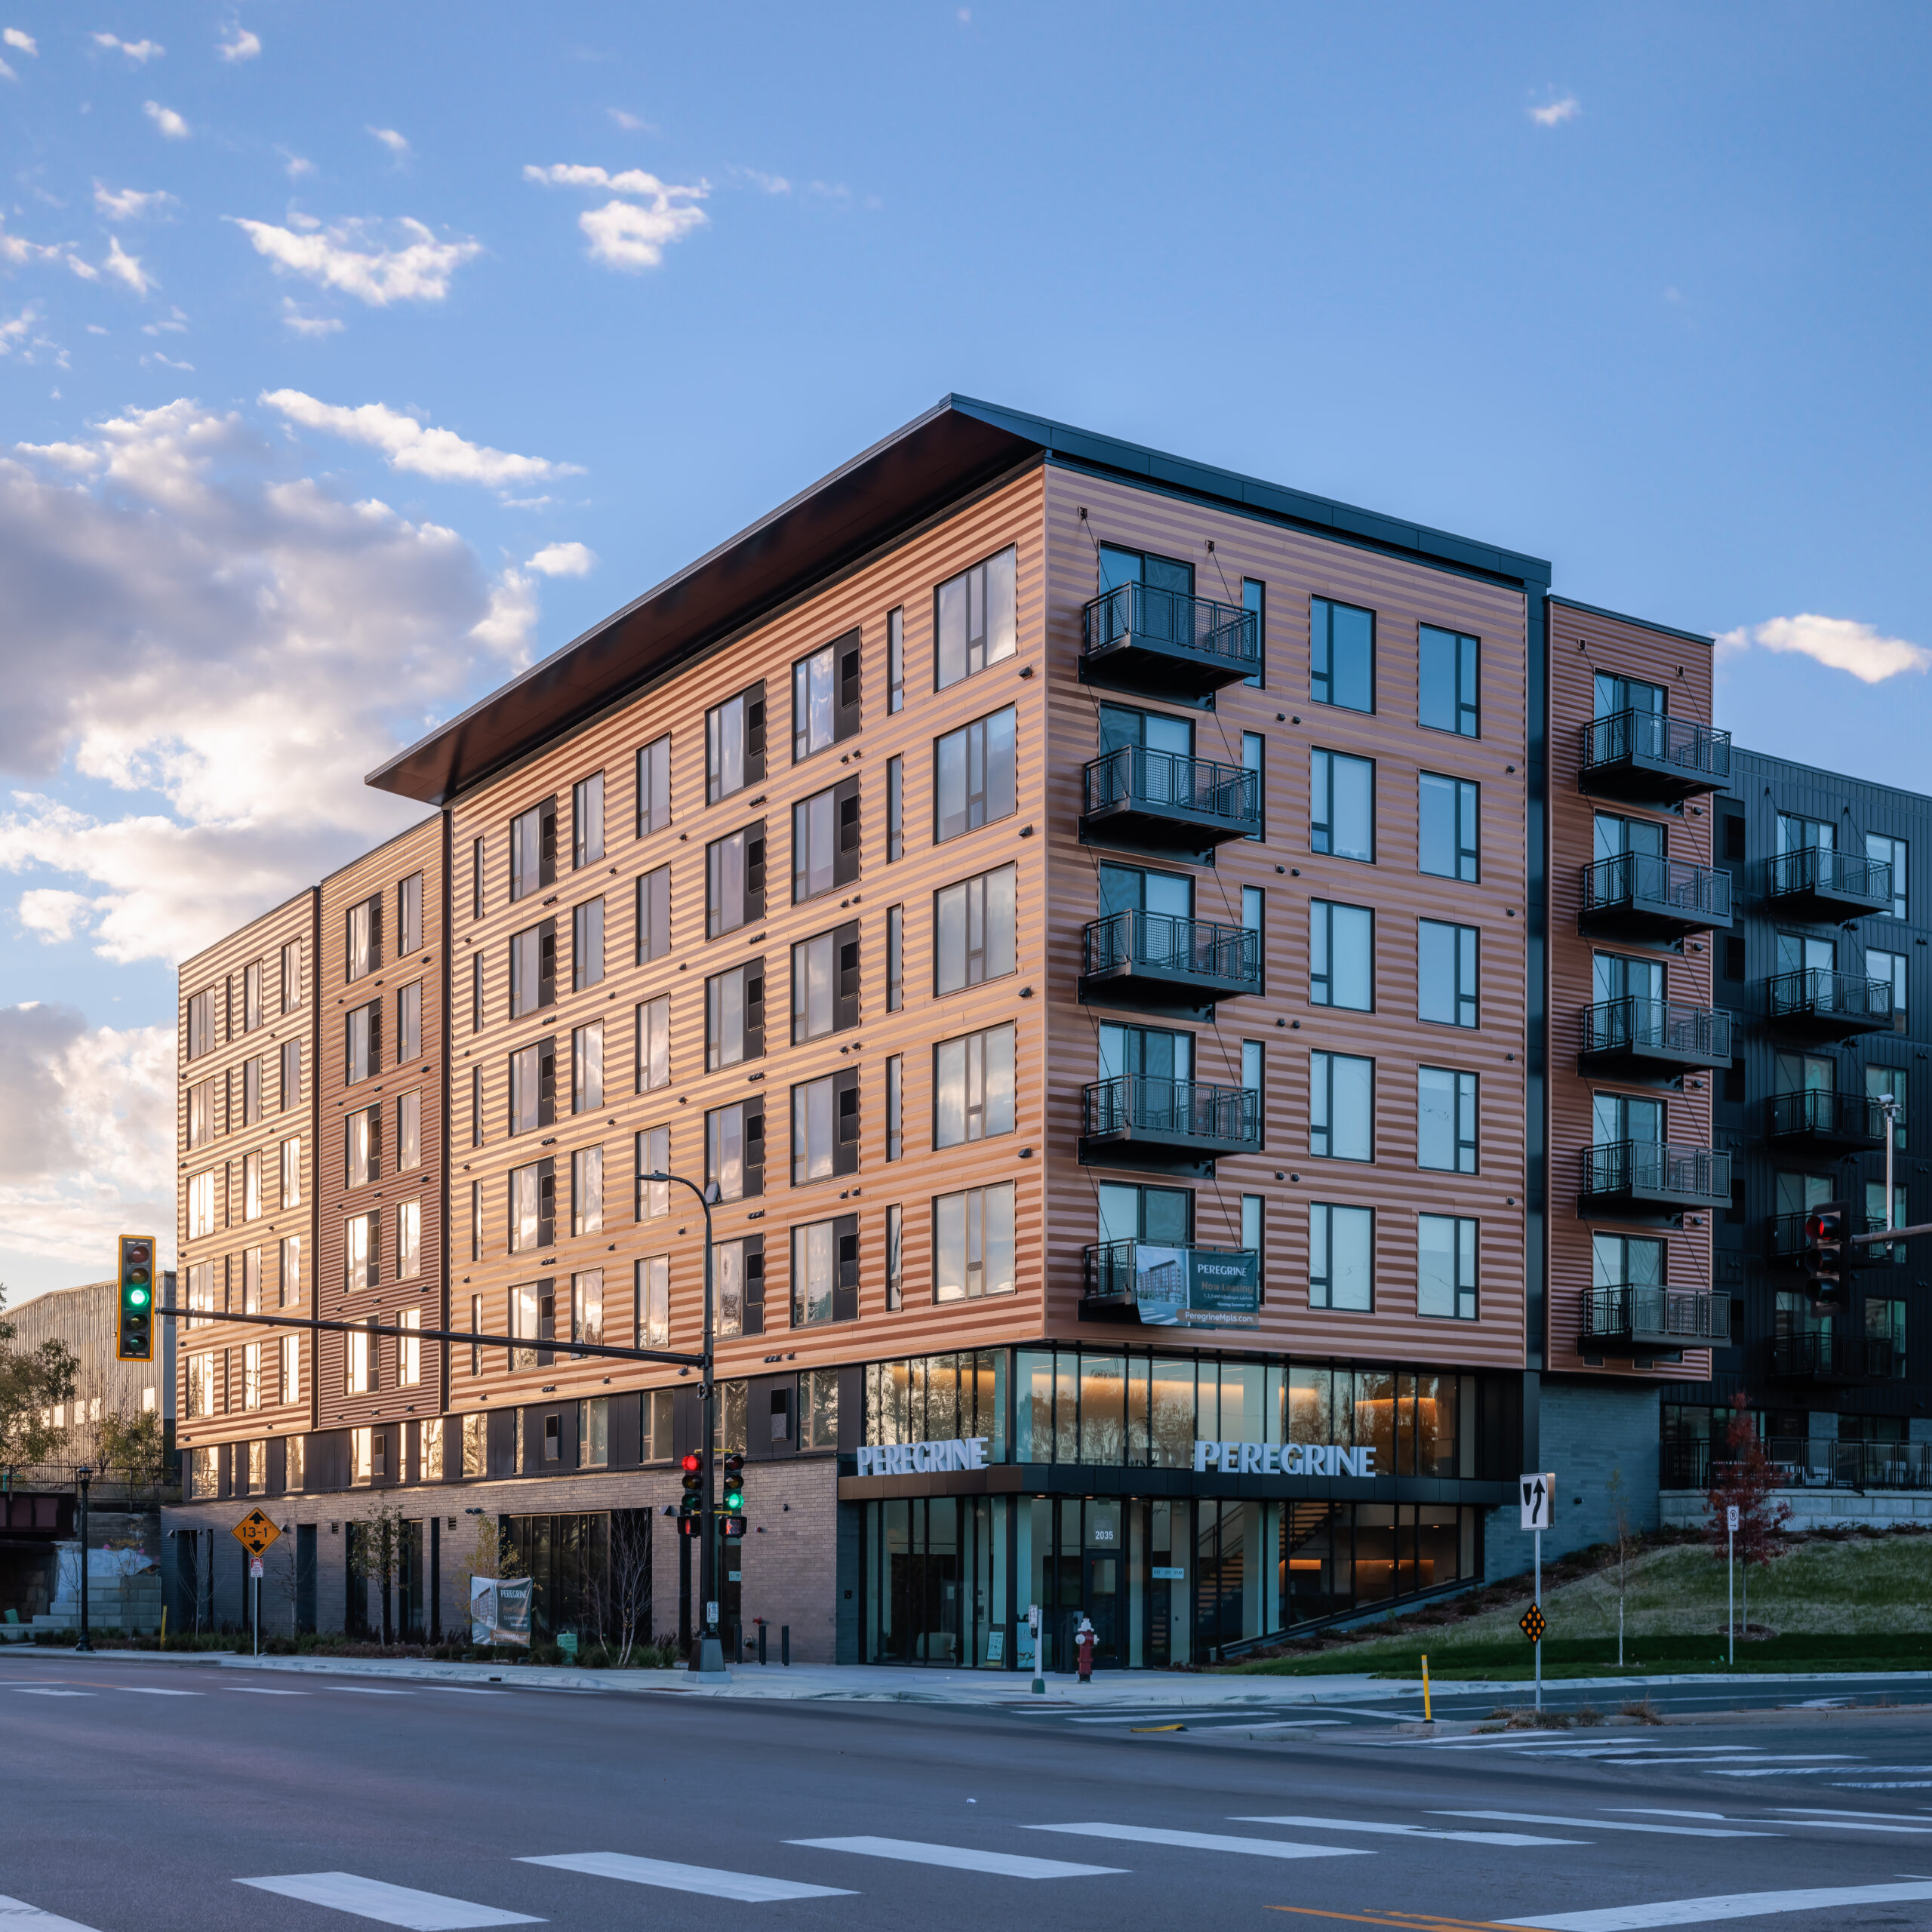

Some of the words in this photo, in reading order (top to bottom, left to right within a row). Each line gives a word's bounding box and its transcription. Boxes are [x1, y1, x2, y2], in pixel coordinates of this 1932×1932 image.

[1197, 1263, 1247, 1277] PEREGRINE
[1201, 1281, 1220, 1291] Now
[1222, 1283, 1254, 1295] Leasing
[1185, 1311, 1254, 1323] PeregrineMpls.com
[857, 1437, 989, 1477] PEREGRINE
[1194, 1440, 1377, 1477] PEREGRINE
[1095, 1531, 1113, 1540] 2035
[500, 1589, 528, 1599] PEREGRINE
